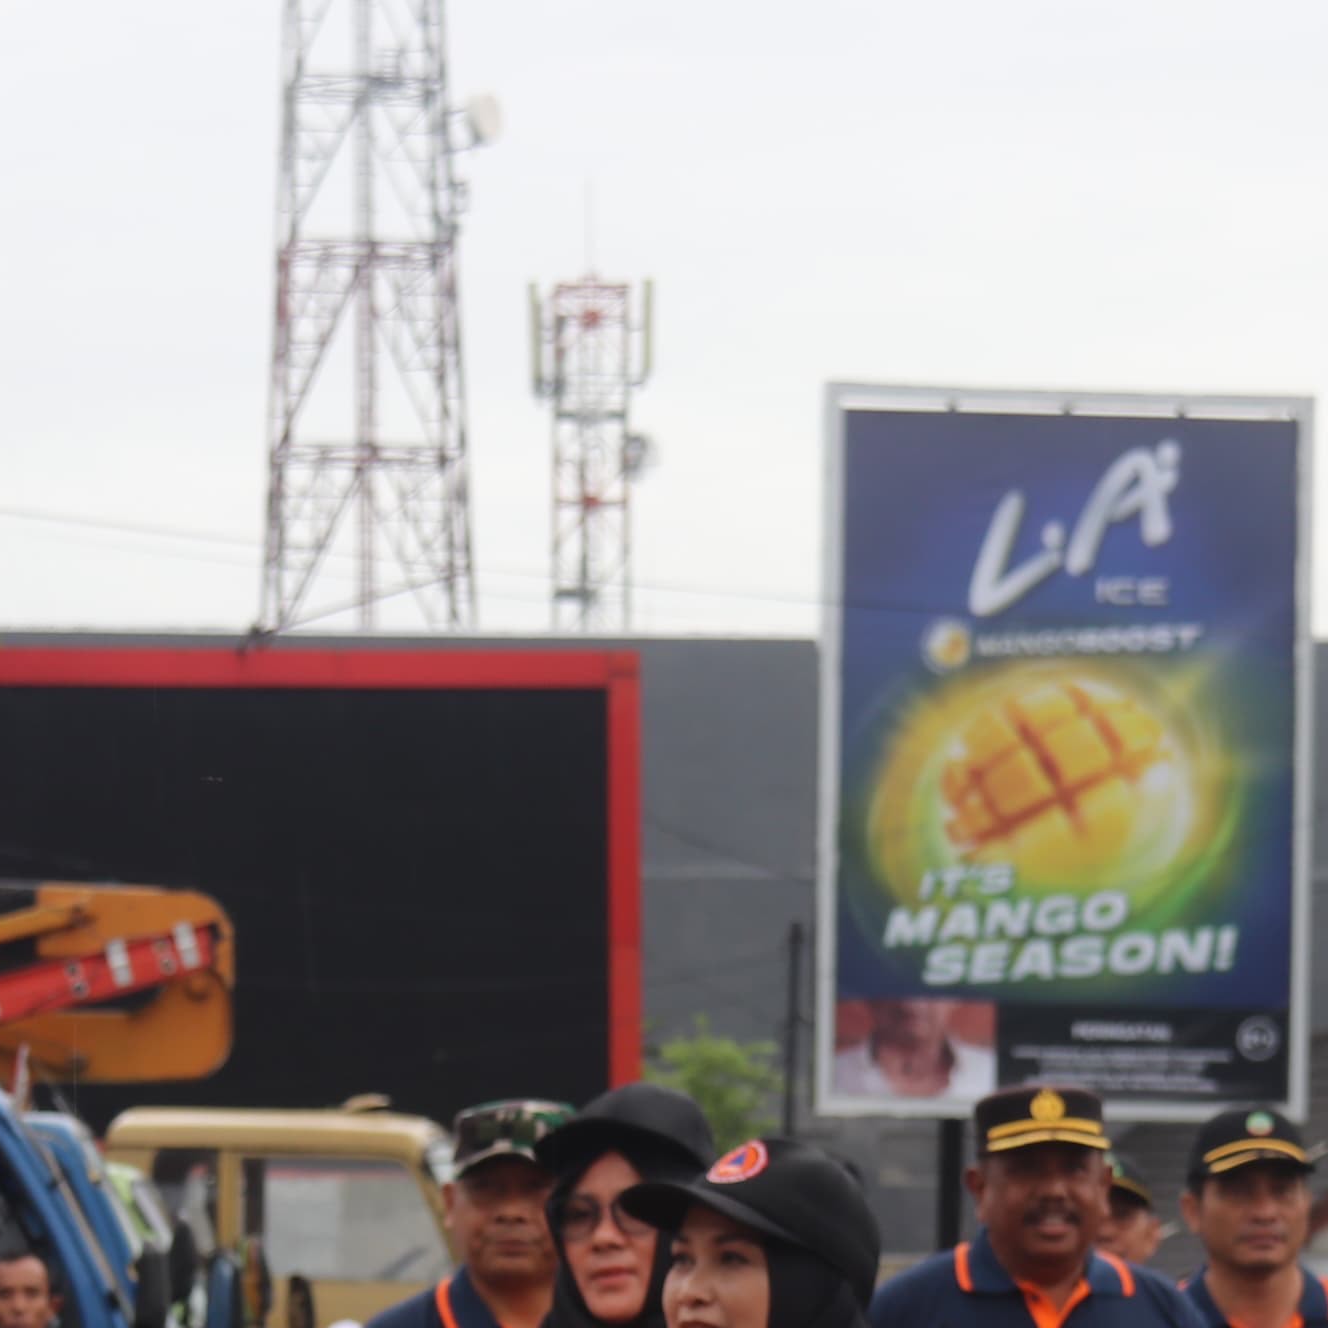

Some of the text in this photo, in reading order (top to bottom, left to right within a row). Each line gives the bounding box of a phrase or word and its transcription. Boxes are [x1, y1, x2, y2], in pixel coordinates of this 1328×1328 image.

[1095, 578, 1169, 605] ICE
[919, 862, 1015, 900] IT'S
[883, 890, 1129, 948] MANGO
[923, 926, 1239, 986] SEASON!
